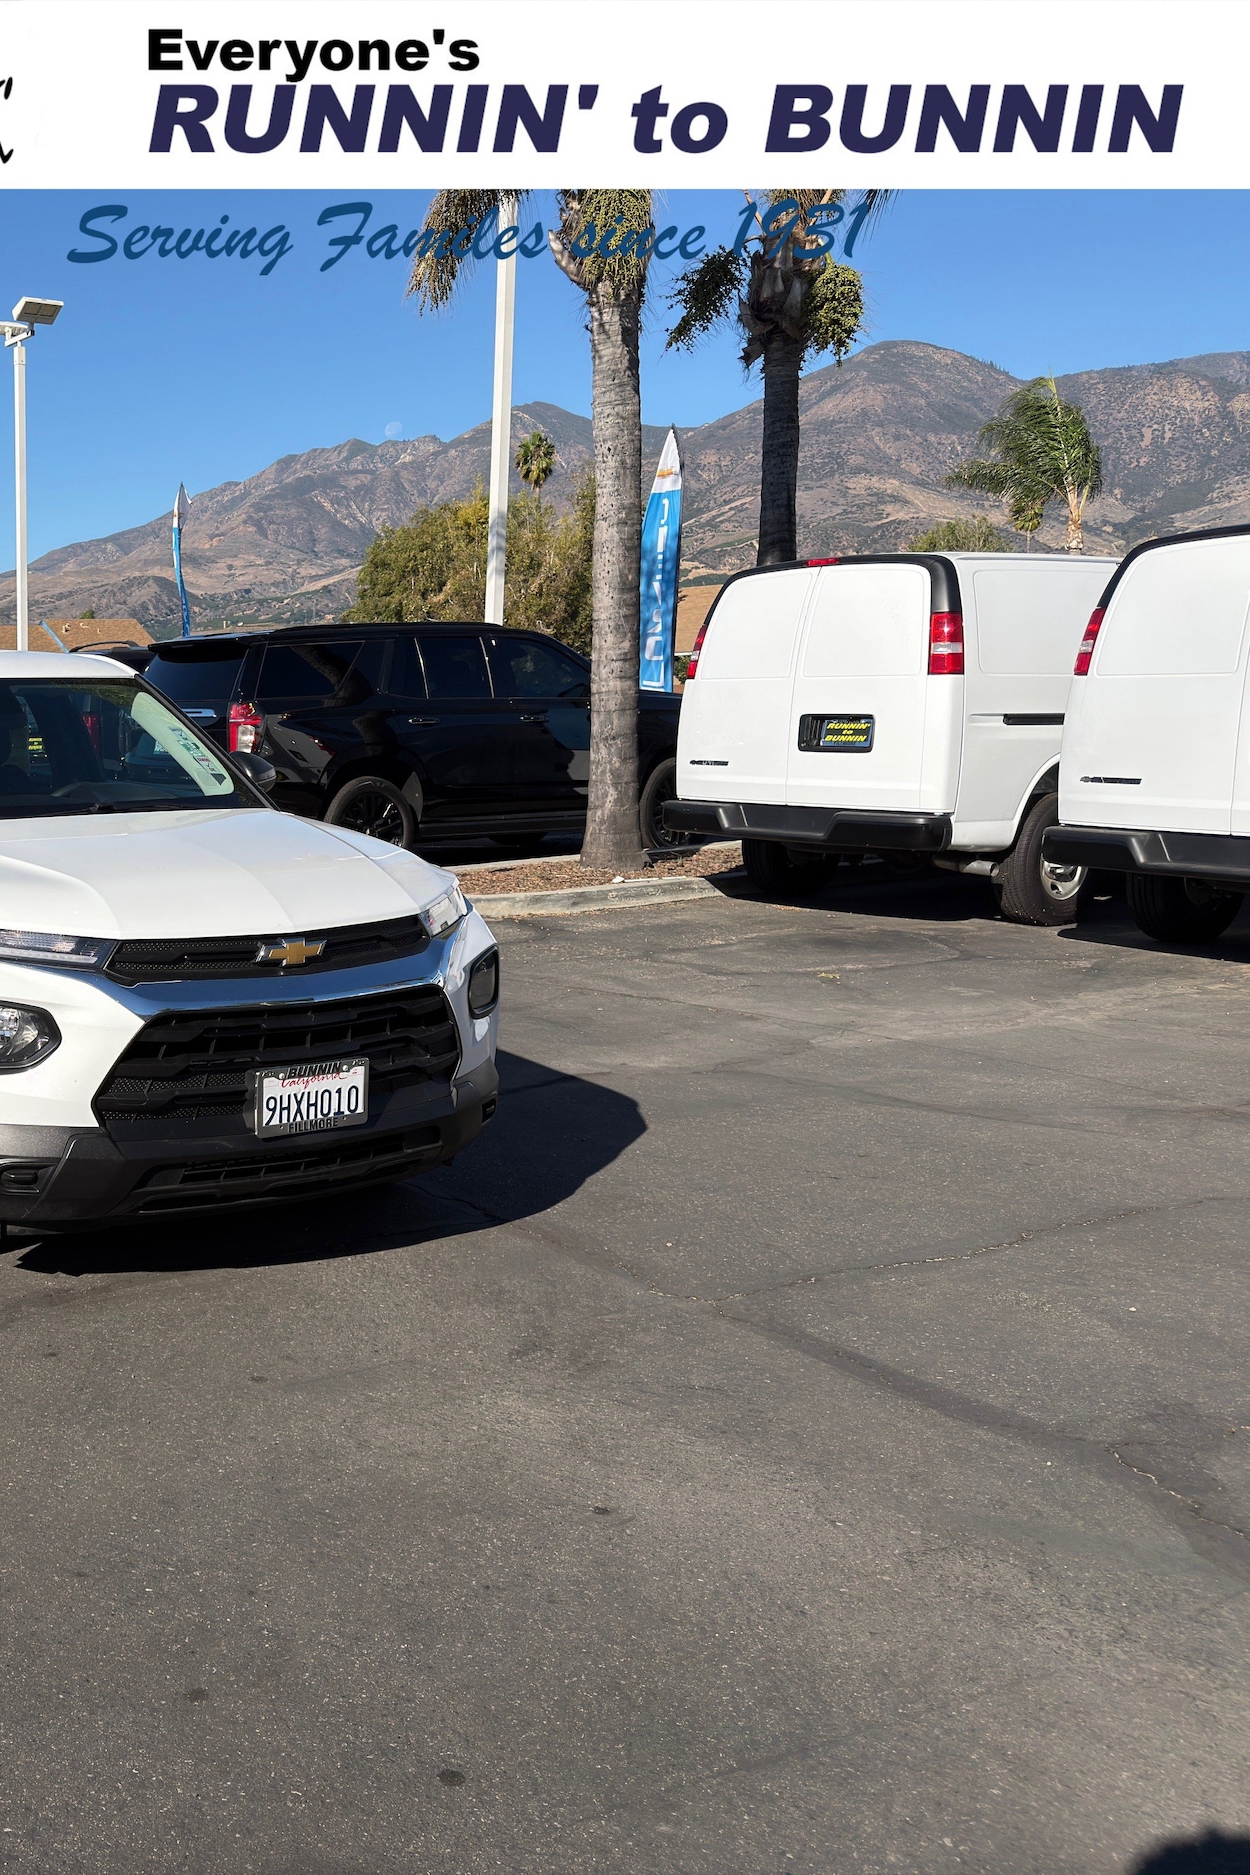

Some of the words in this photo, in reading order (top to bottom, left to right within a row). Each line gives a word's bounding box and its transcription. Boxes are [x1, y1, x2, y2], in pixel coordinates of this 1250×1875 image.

[286, 1061, 343, 1079] BUNNIN
[264, 1085, 359, 1126] 9HXH010
[288, 1117, 339, 1134] FILLMORE
